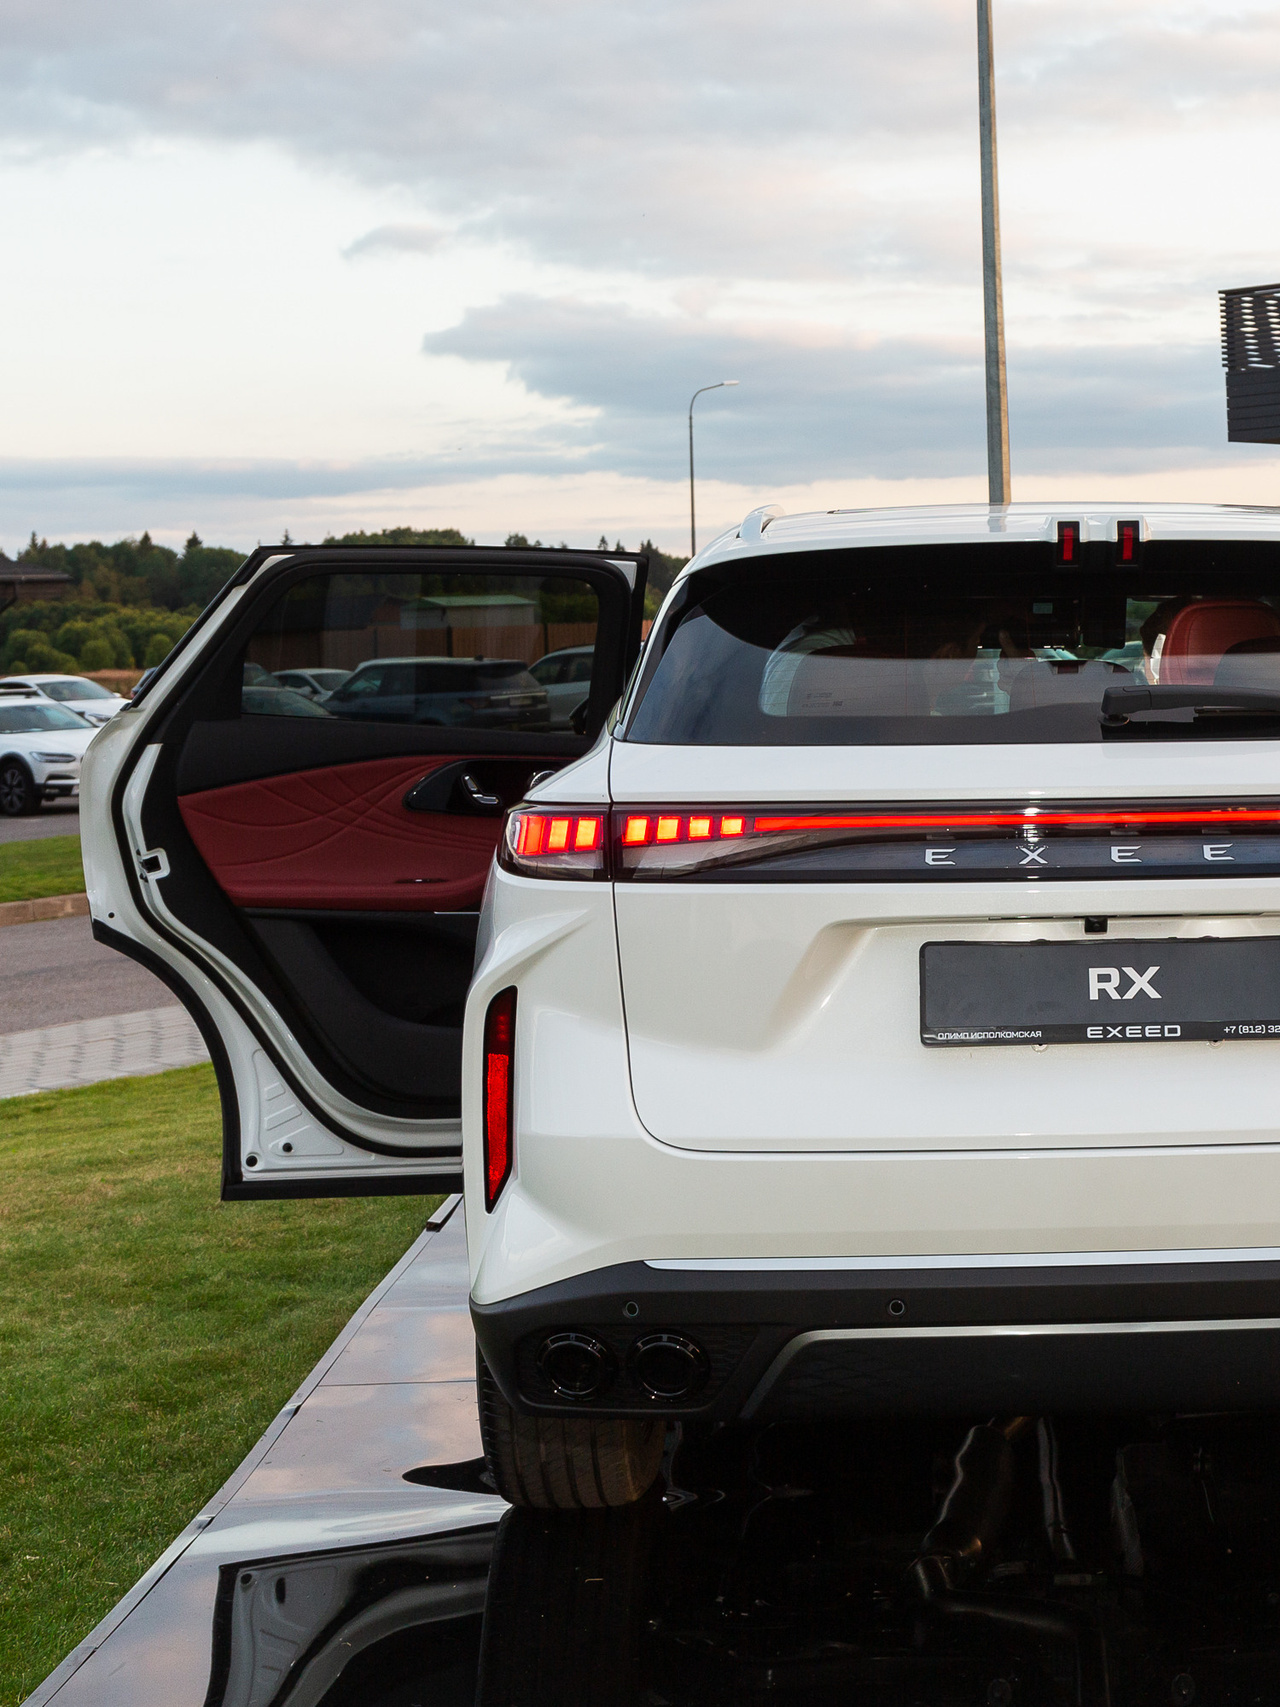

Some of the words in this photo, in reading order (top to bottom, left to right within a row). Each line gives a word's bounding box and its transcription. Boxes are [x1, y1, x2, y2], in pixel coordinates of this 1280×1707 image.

[1088, 966, 1163, 1000] RX
[1086, 1024, 1181, 1038] EXEED
[1223, 1025, 1236, 1034] +7
[1238, 1024, 1265, 1034] (812)
